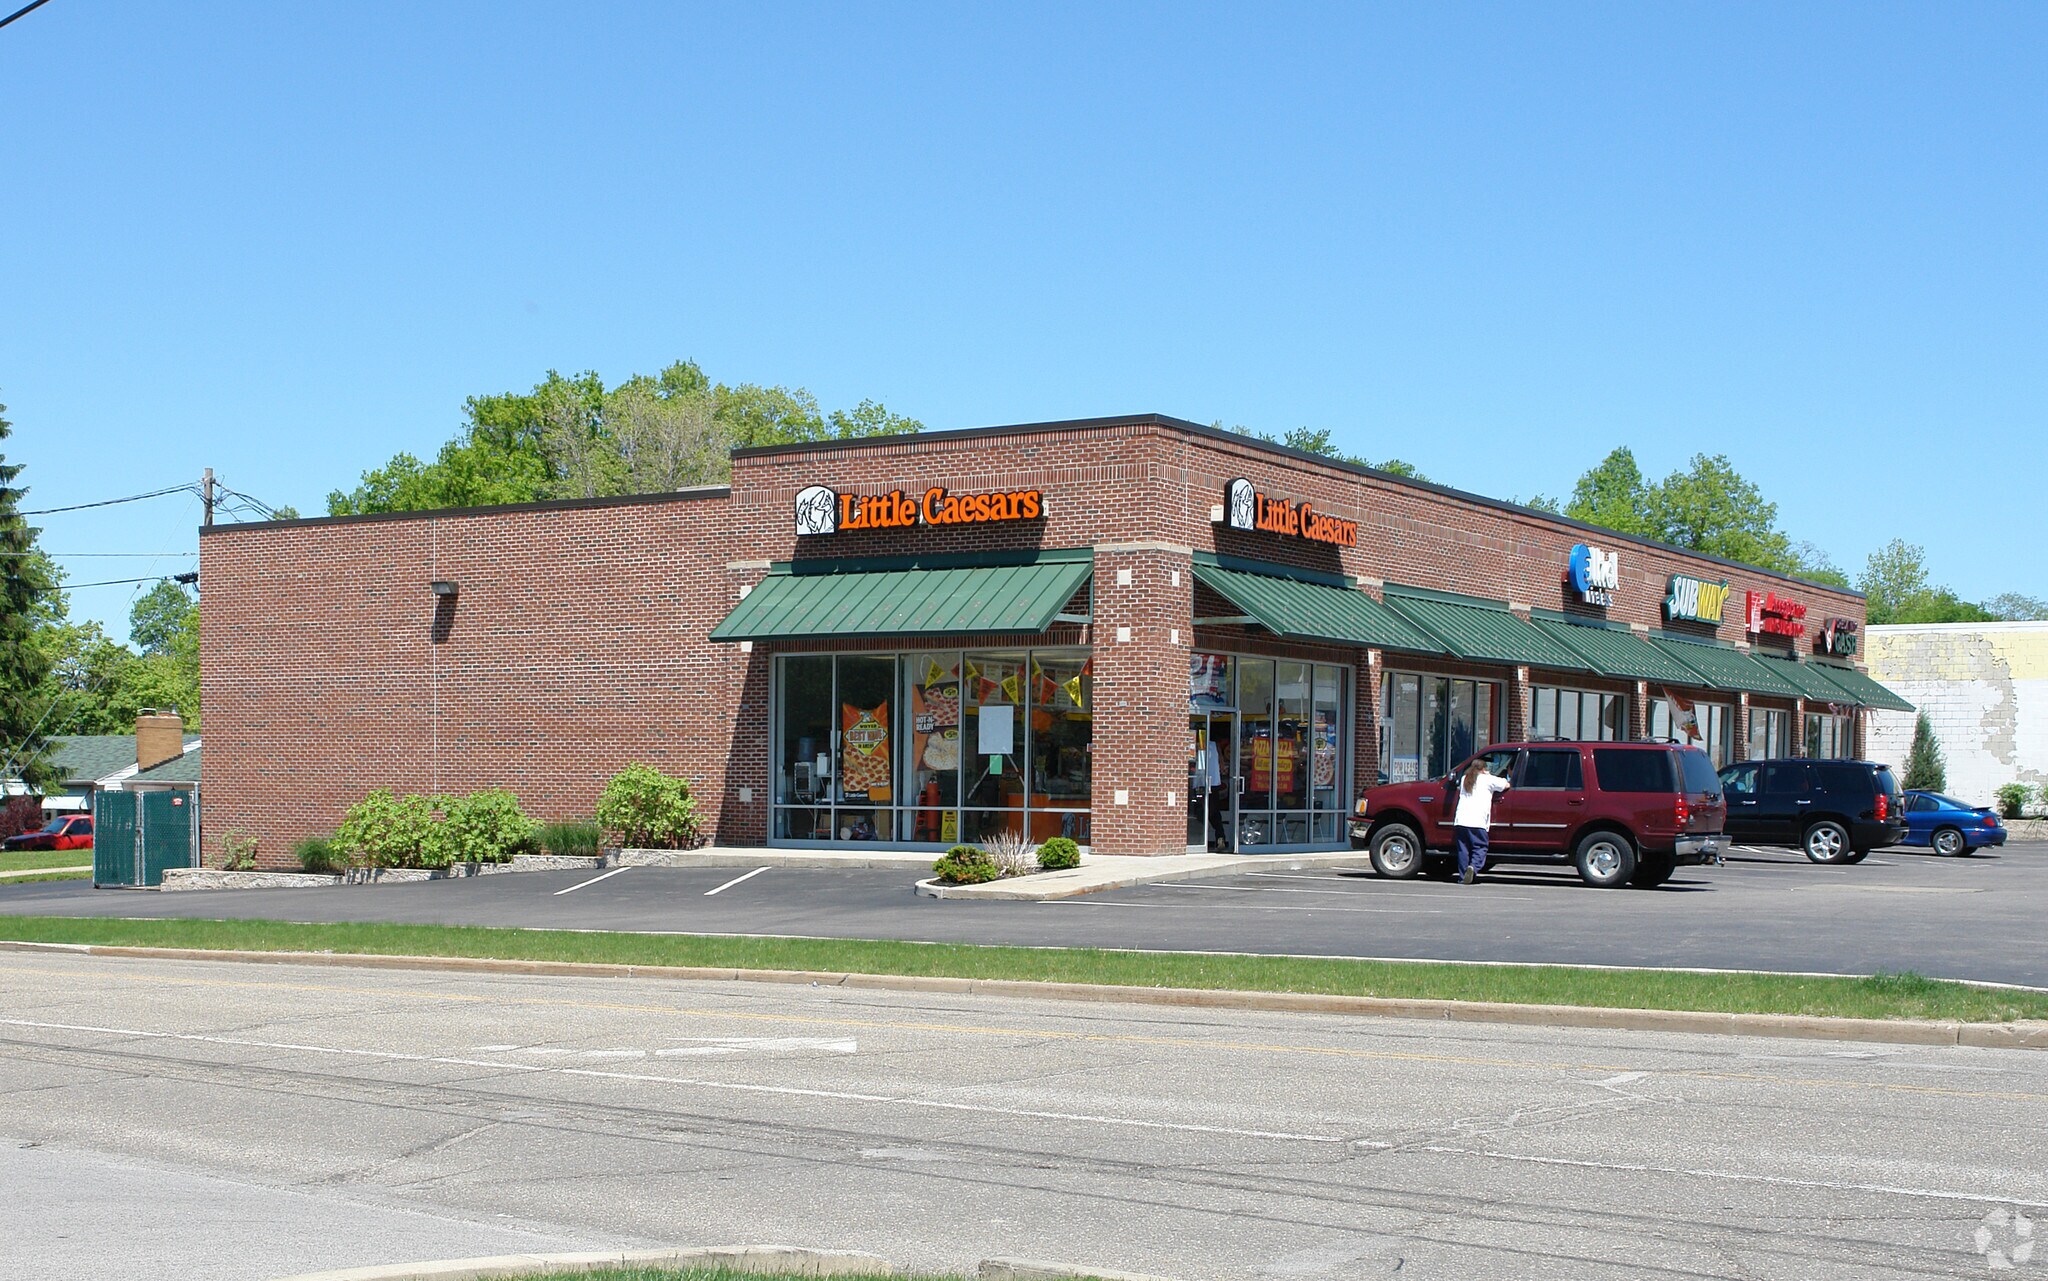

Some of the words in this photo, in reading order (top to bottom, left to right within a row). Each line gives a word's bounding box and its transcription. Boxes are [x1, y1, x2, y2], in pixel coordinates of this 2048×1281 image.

[838, 490, 916, 530] Little
[922, 487, 1041, 525] Caesars
[1256, 493, 1299, 535] Little
[1301, 502, 1357, 547] Caesars
[1670, 575, 1729, 621] SUBWAY
[1834, 632, 1857, 655] CASH
[1394, 762, 1403, 774] FOR
[1404, 762, 1418, 775] LEASE
